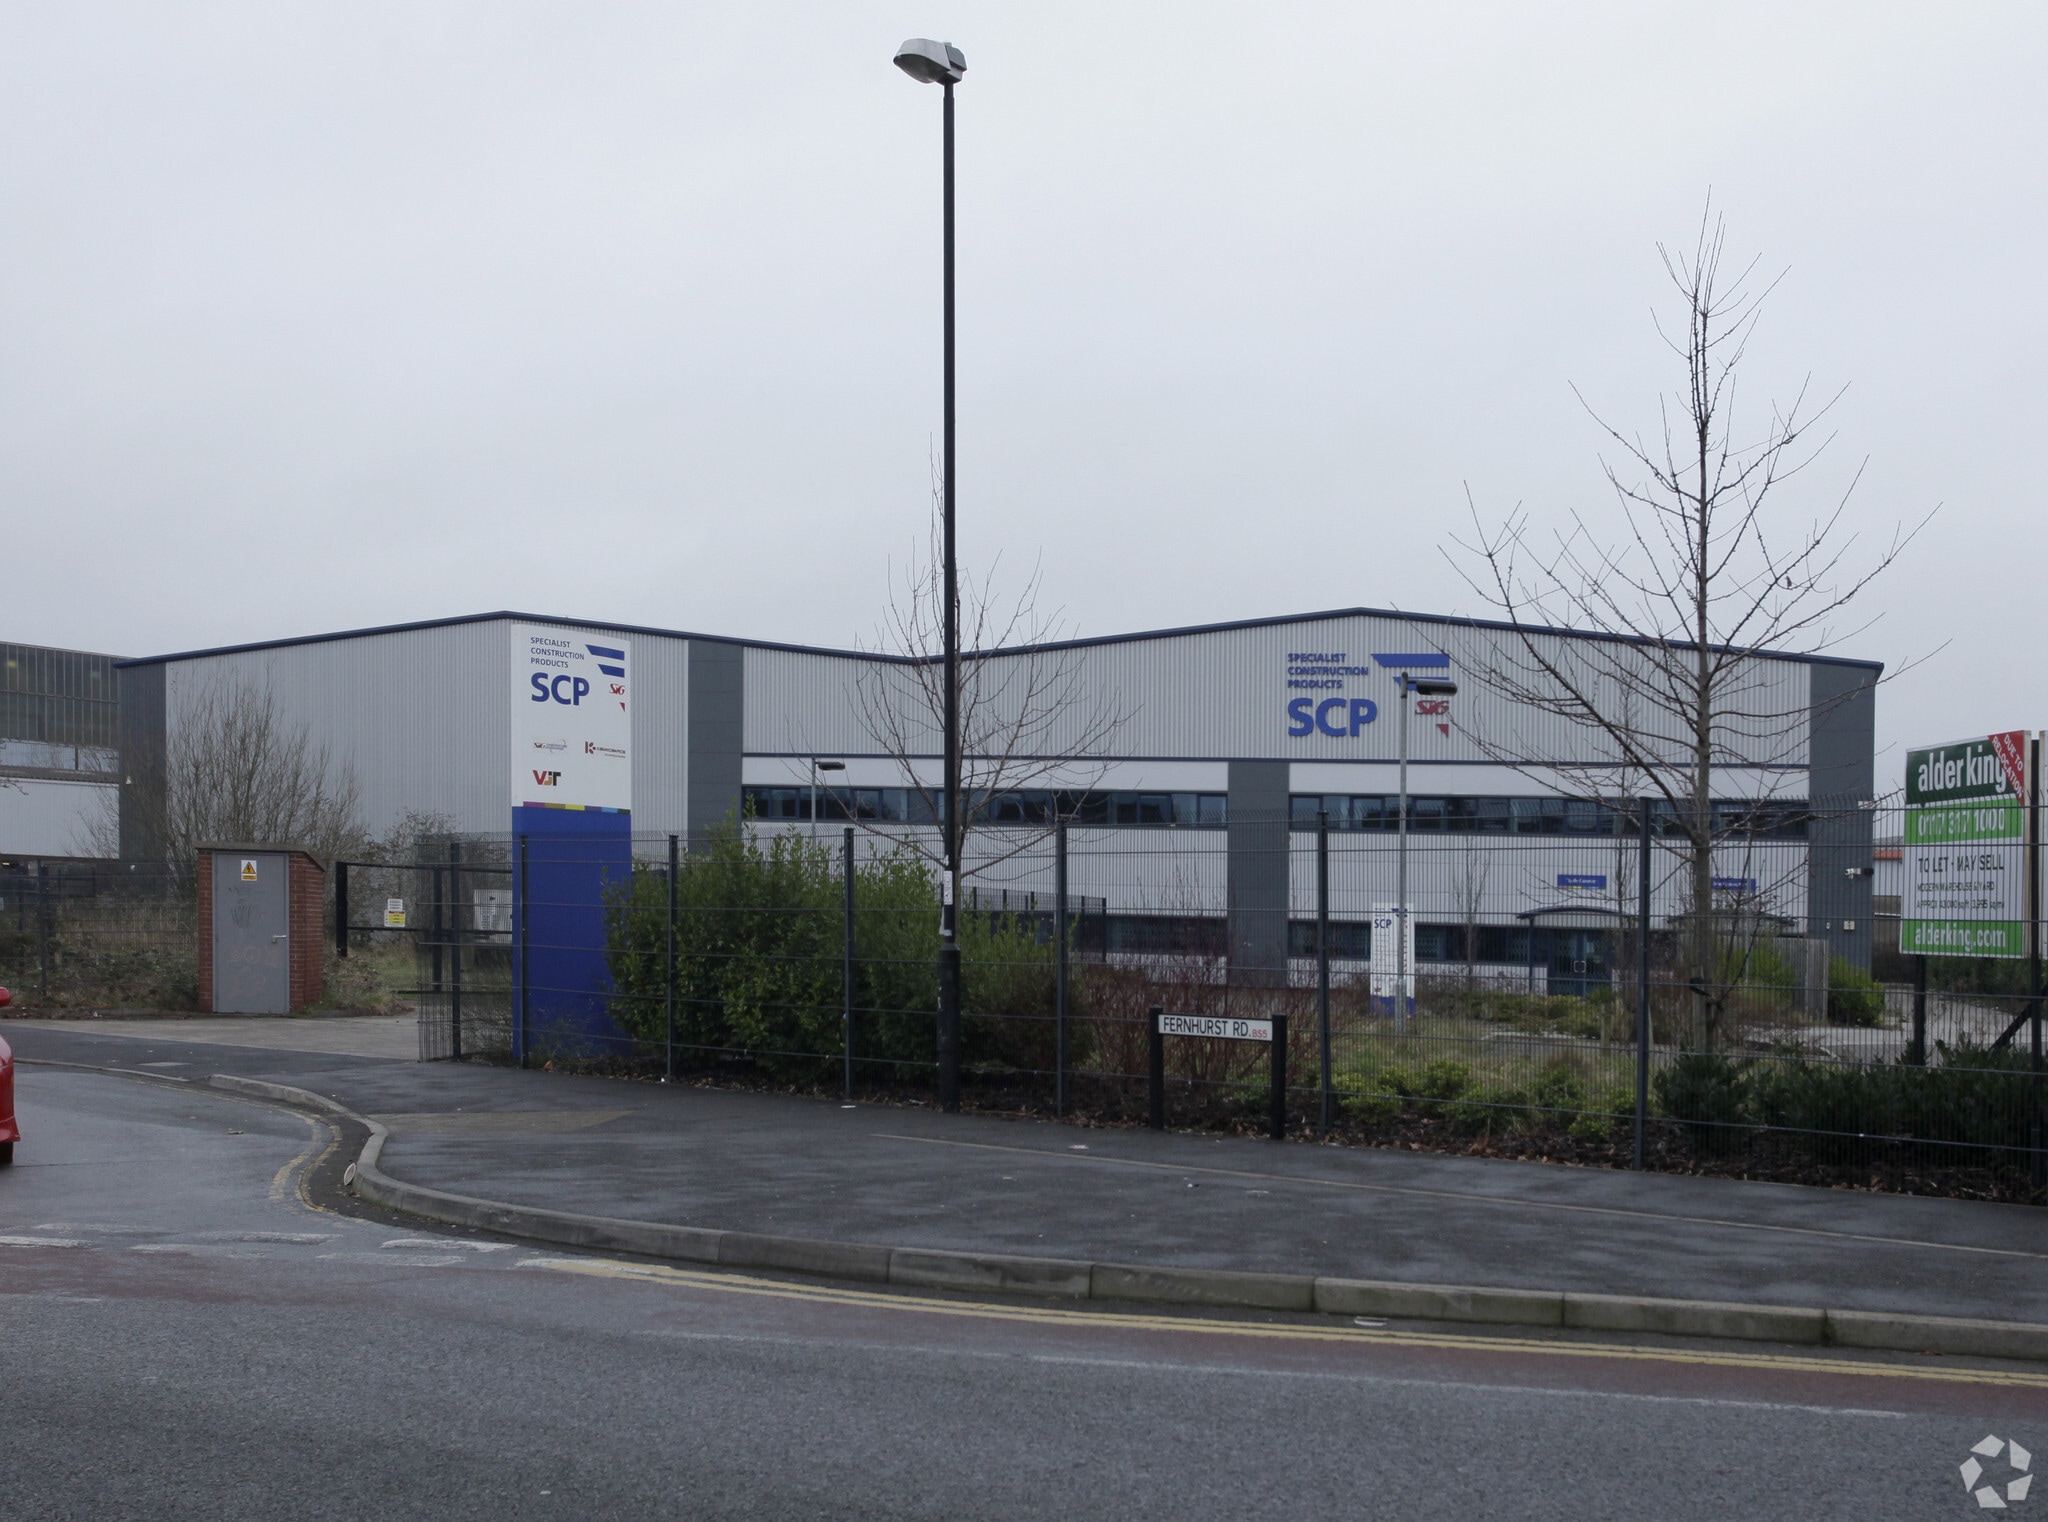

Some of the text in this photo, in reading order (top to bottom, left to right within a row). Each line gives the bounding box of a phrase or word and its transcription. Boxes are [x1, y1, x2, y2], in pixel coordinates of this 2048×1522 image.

[530, 637, 571, 648] SPECIALIST
[530, 647, 585, 660] CONSTRUCTION
[530, 657, 569, 669] PRODUCTS
[1287, 653, 1346, 663] SPECIALIST
[1287, 666, 1369, 676] CONSTRUCTION
[530, 672, 590, 706] SCP
[1287, 679, 1343, 689] PRODUCTS
[1287, 697, 1378, 737] SCP
[2003, 733, 2024, 772] DUE TO
[1991, 735, 2024, 799] RELOCATION
[1918, 807, 2005, 836] 0117 317 1000
[1918, 853, 2005, 873] TO LET MAY SELL
[1374, 919, 1392, 929] SCP
[1915, 922, 2006, 952] alderking.com
[1163, 1016, 1228, 1036] FERNHURST
[1252, 1029, 1268, 1038] BS5
